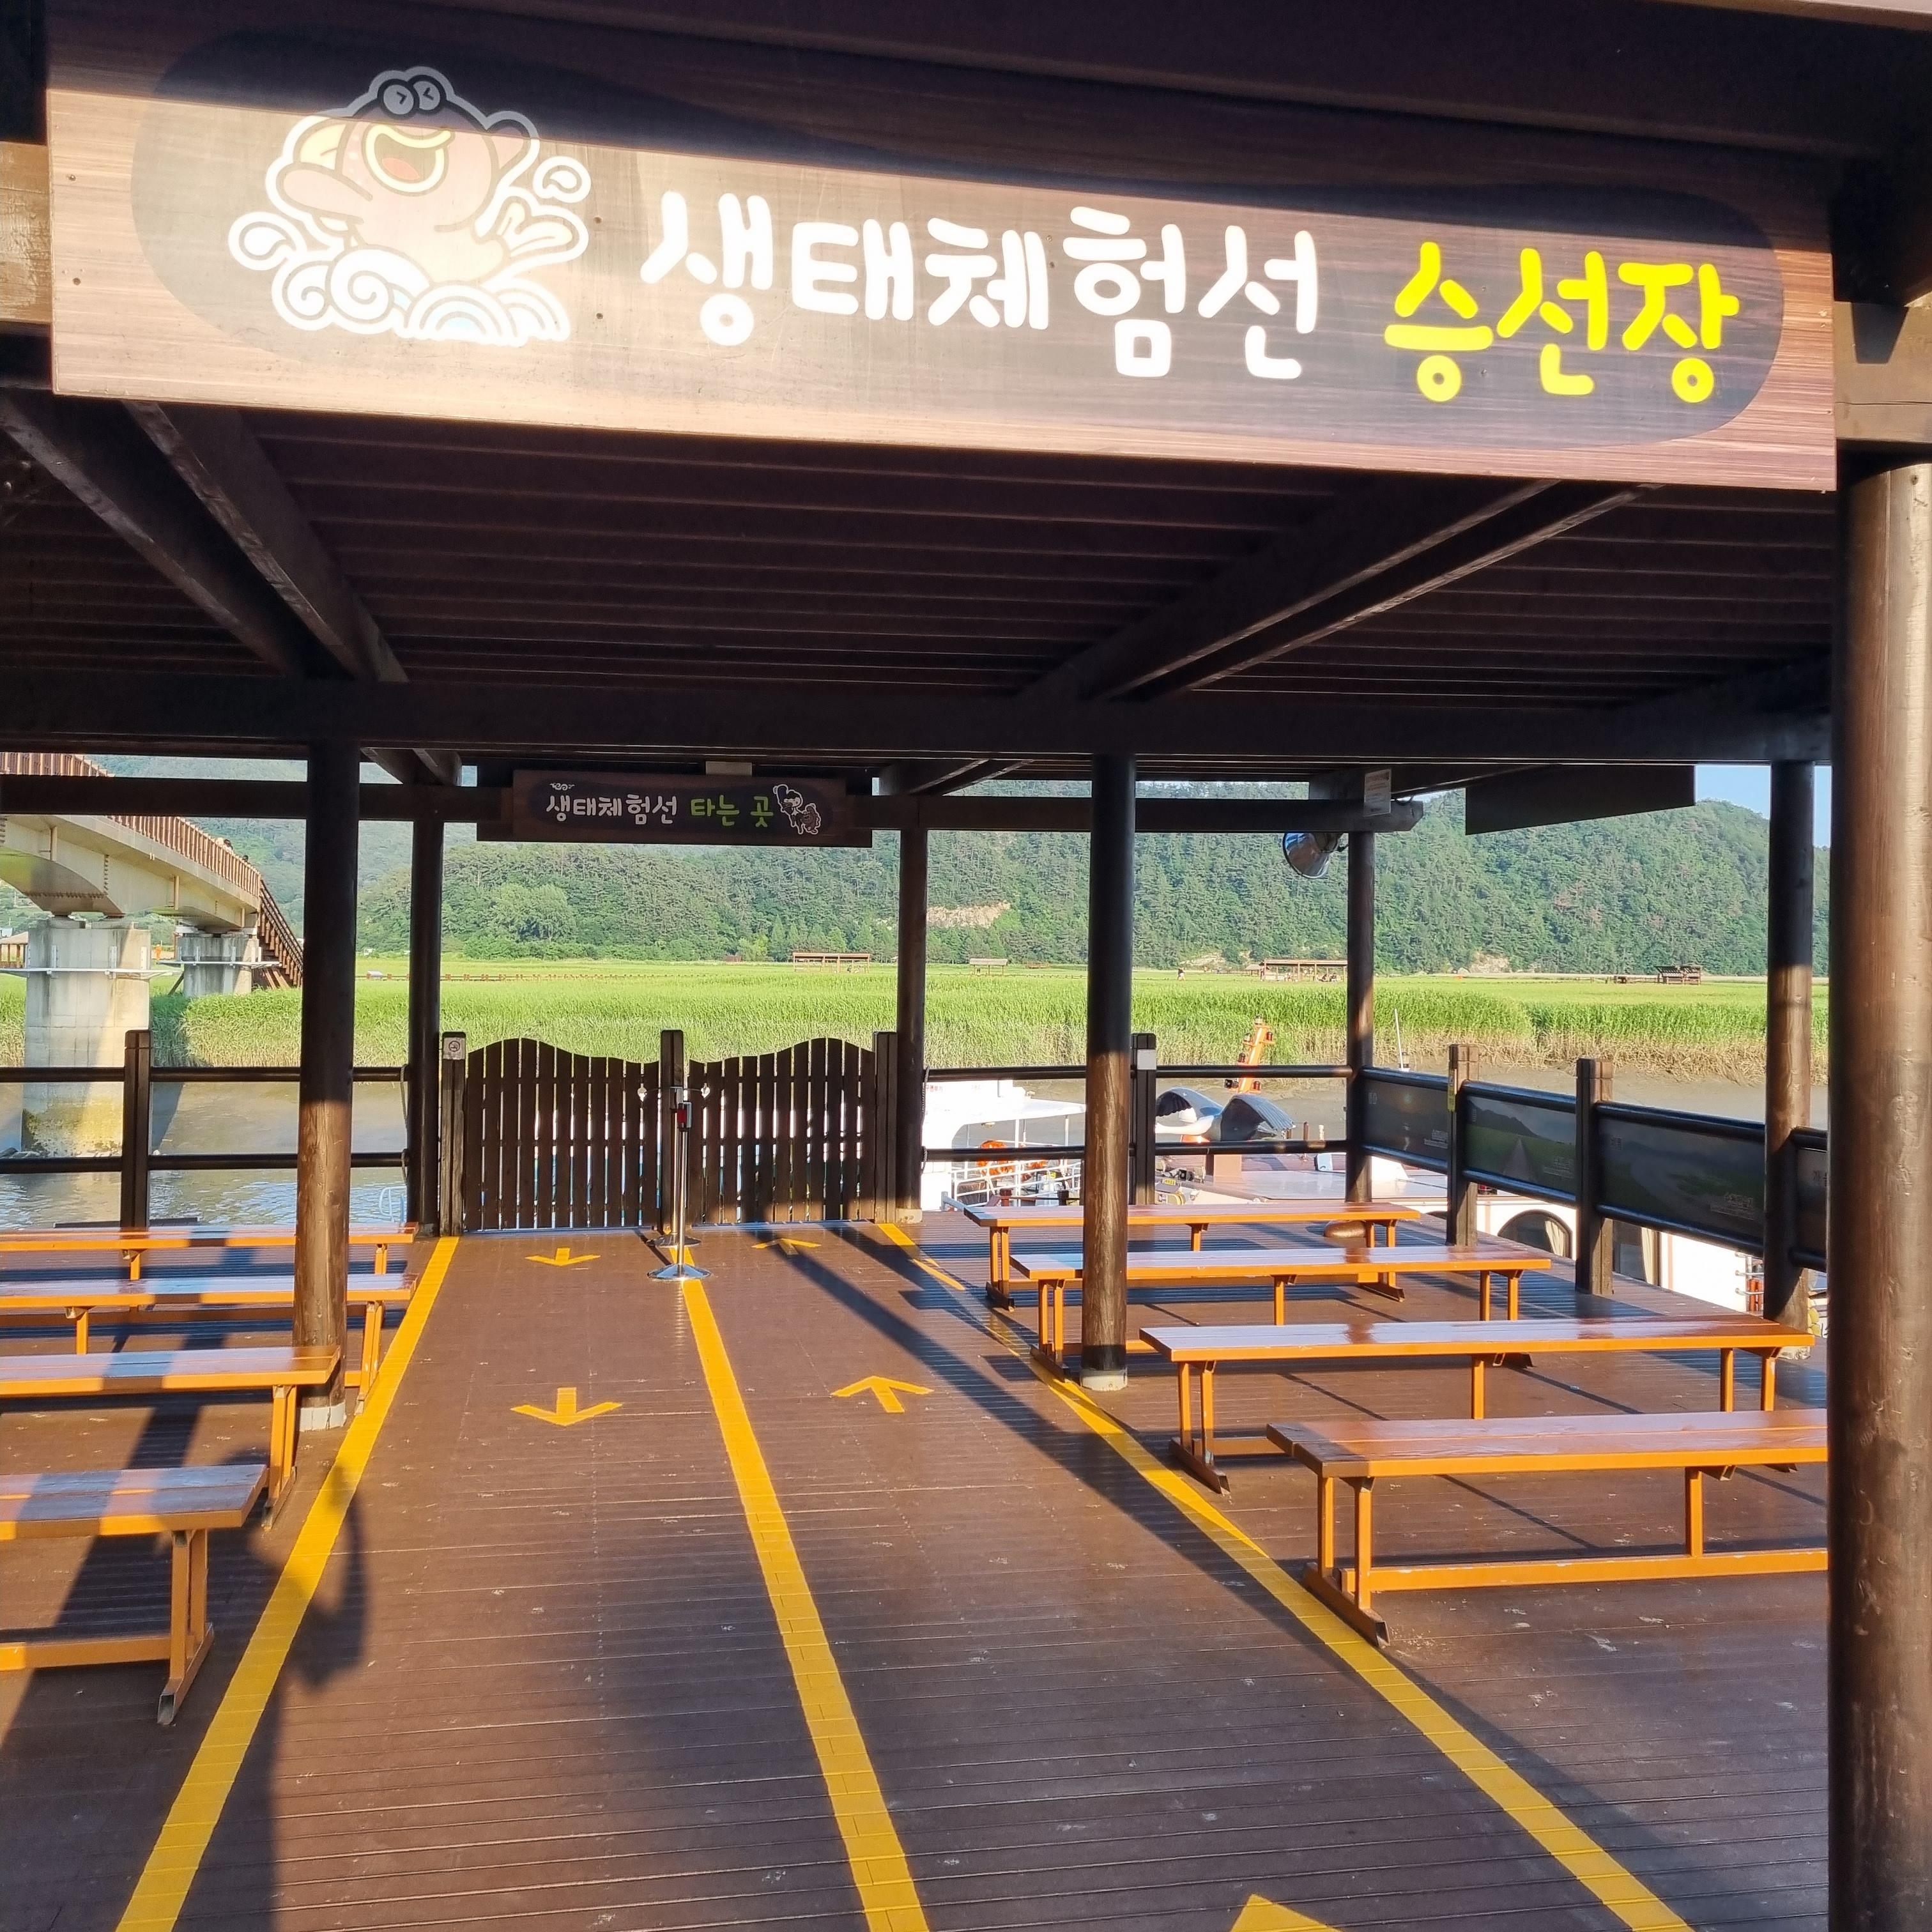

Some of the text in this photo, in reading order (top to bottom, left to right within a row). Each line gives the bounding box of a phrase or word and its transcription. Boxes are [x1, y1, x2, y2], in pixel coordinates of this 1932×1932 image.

[640, 192, 1740, 402] 생태체험선 승선장
[546, 795, 774, 827] 생태체험선 타는 곳
